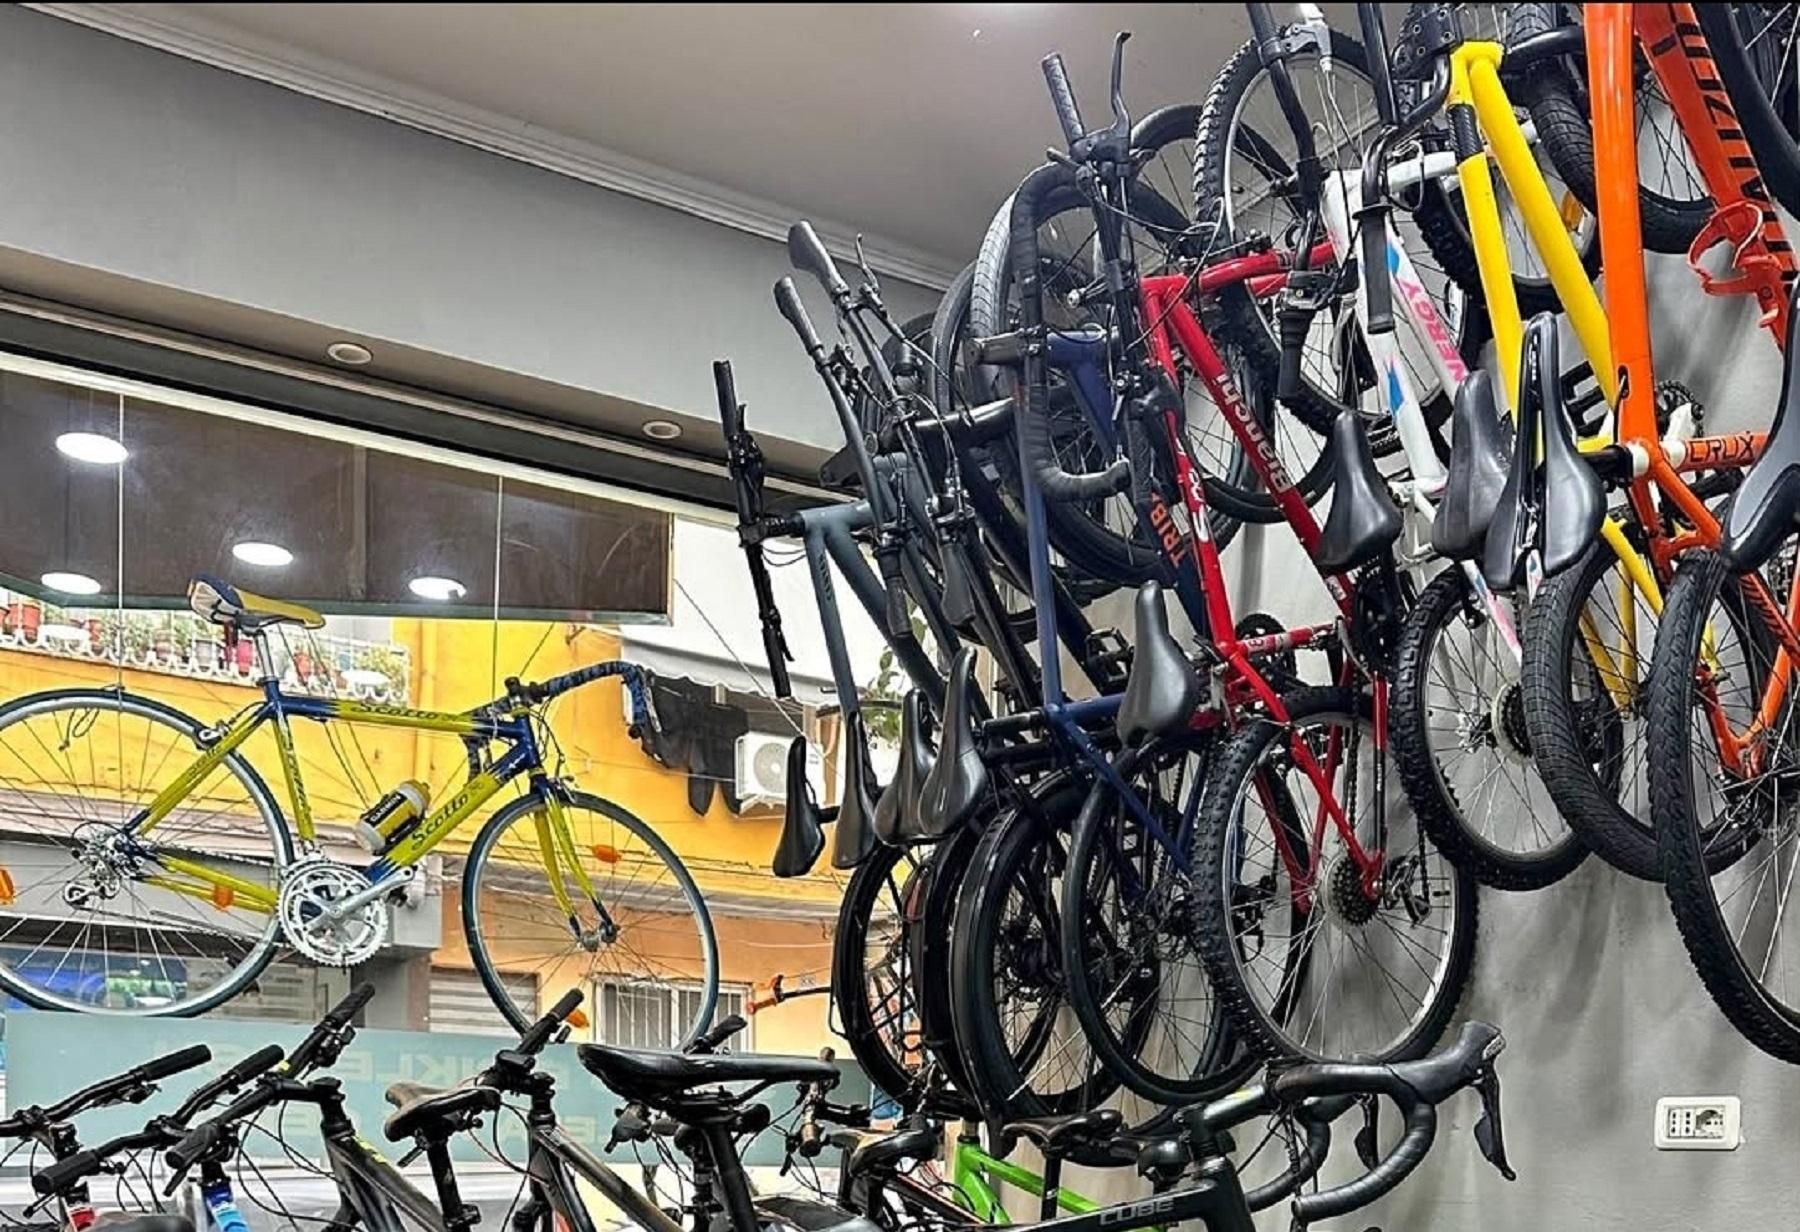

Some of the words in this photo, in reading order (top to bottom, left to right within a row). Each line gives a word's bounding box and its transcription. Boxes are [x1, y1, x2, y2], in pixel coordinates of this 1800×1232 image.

[1214, 373, 1294, 493] Bianchi
[1689, 436, 1754, 461] CRUX
[370, 794, 401, 822] GARMIN
[1099, 1199, 1174, 1226] CUBE
